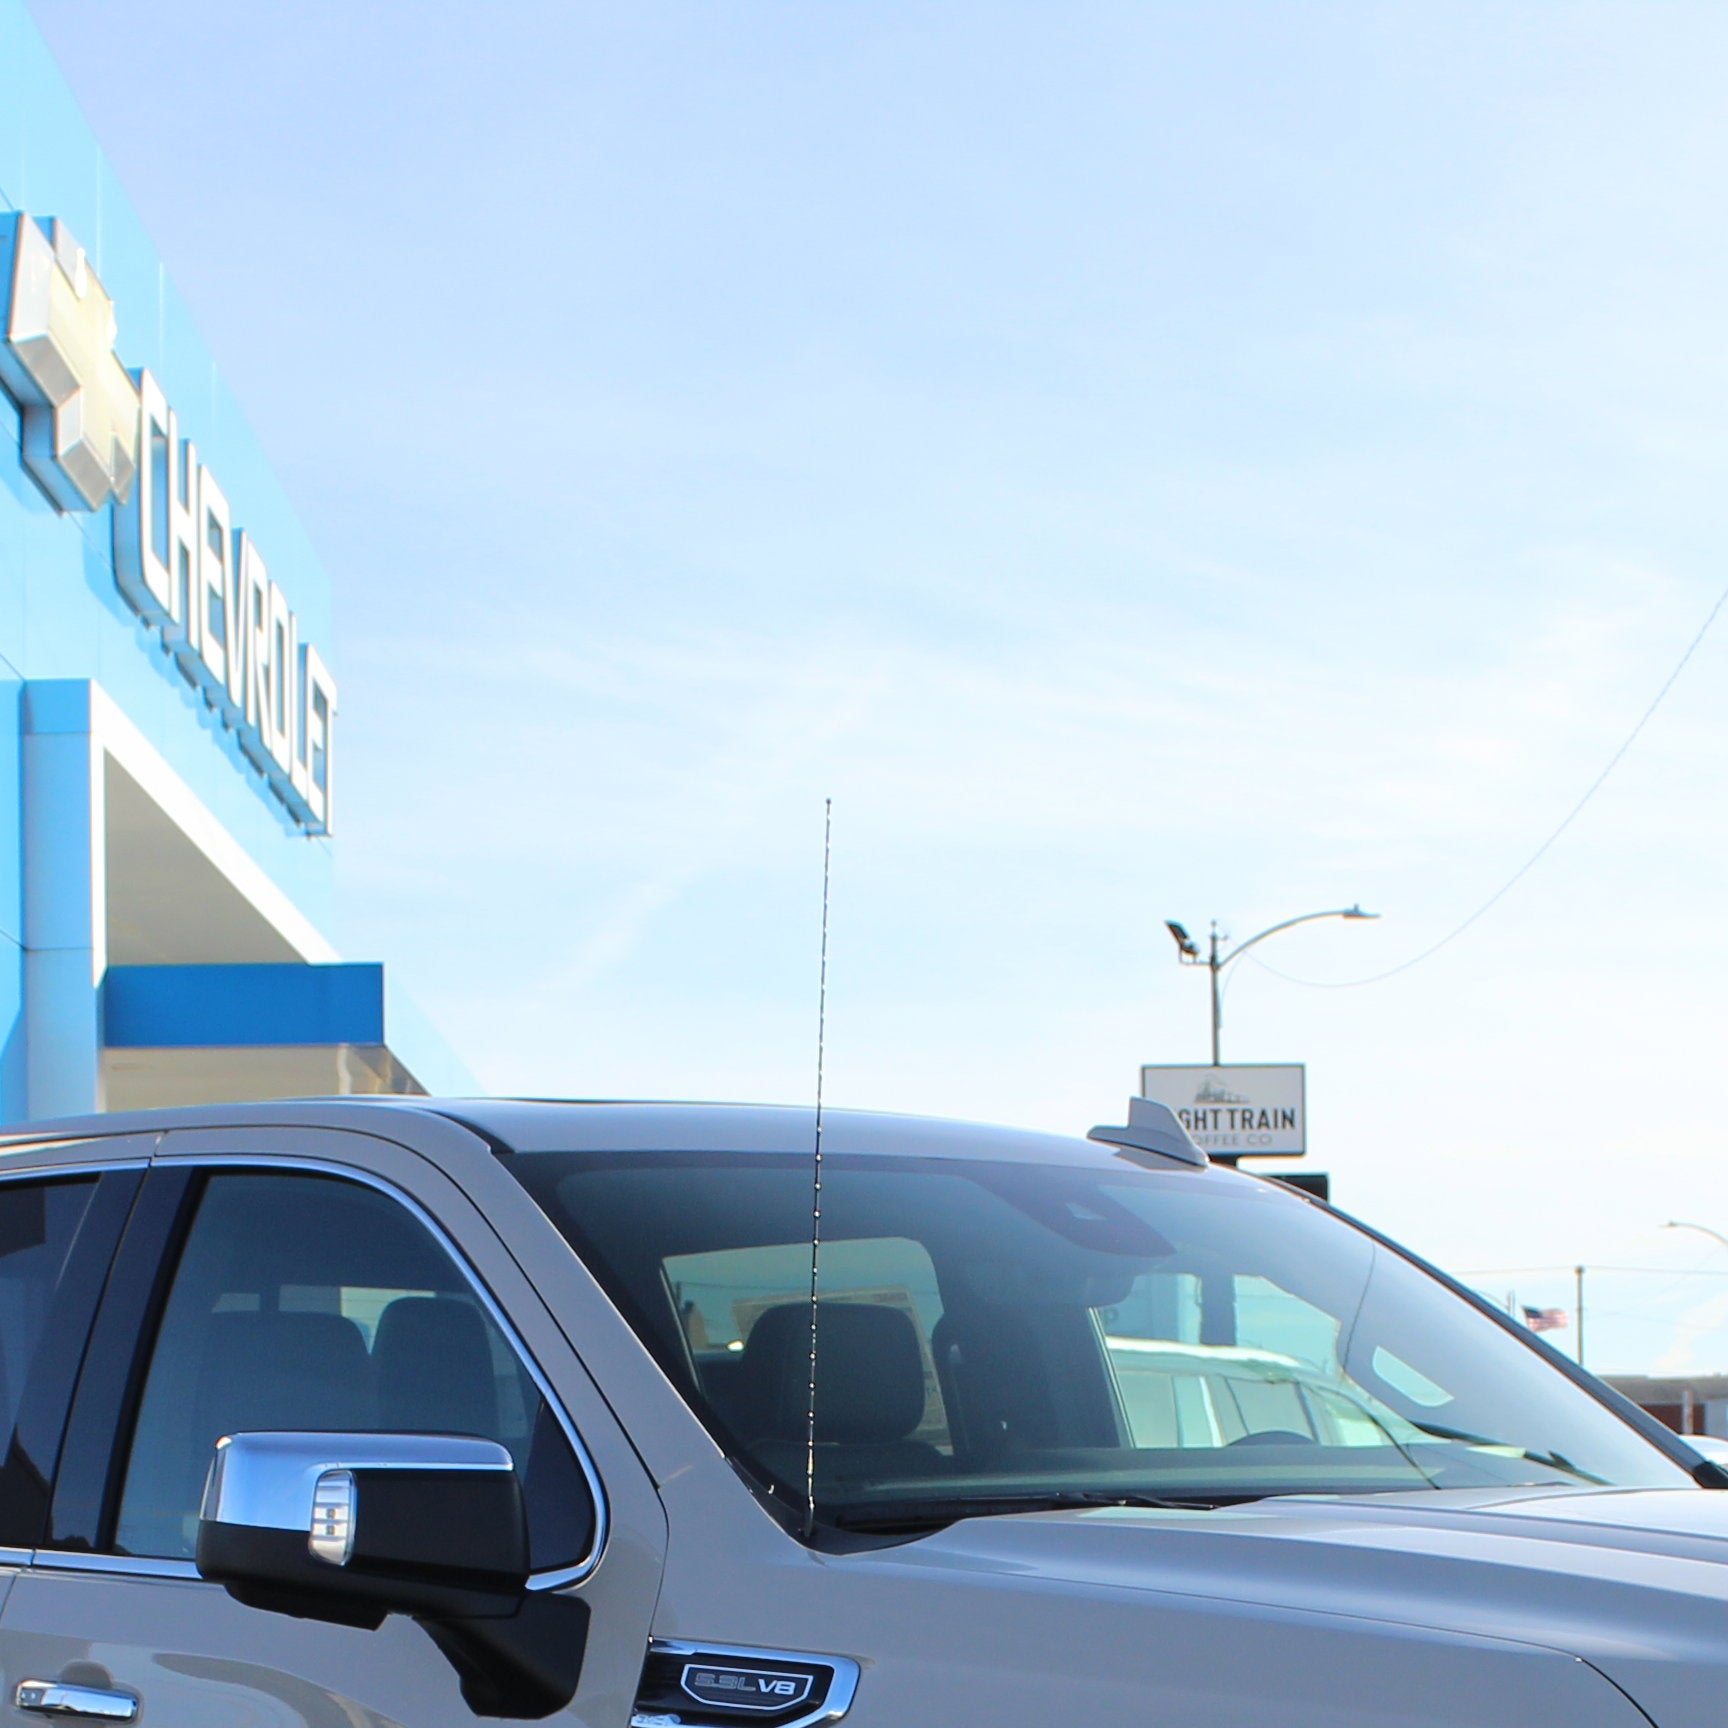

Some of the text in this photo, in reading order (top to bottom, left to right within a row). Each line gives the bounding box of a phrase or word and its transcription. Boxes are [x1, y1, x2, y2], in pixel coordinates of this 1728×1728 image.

[113, 367, 338, 836] CHEVROLET
[1178, 1107, 1296, 1131] GHT TRAIN
[1194, 1133, 1273, 1146] OFFEE CO
[758, 1678, 796, 1696] V8
